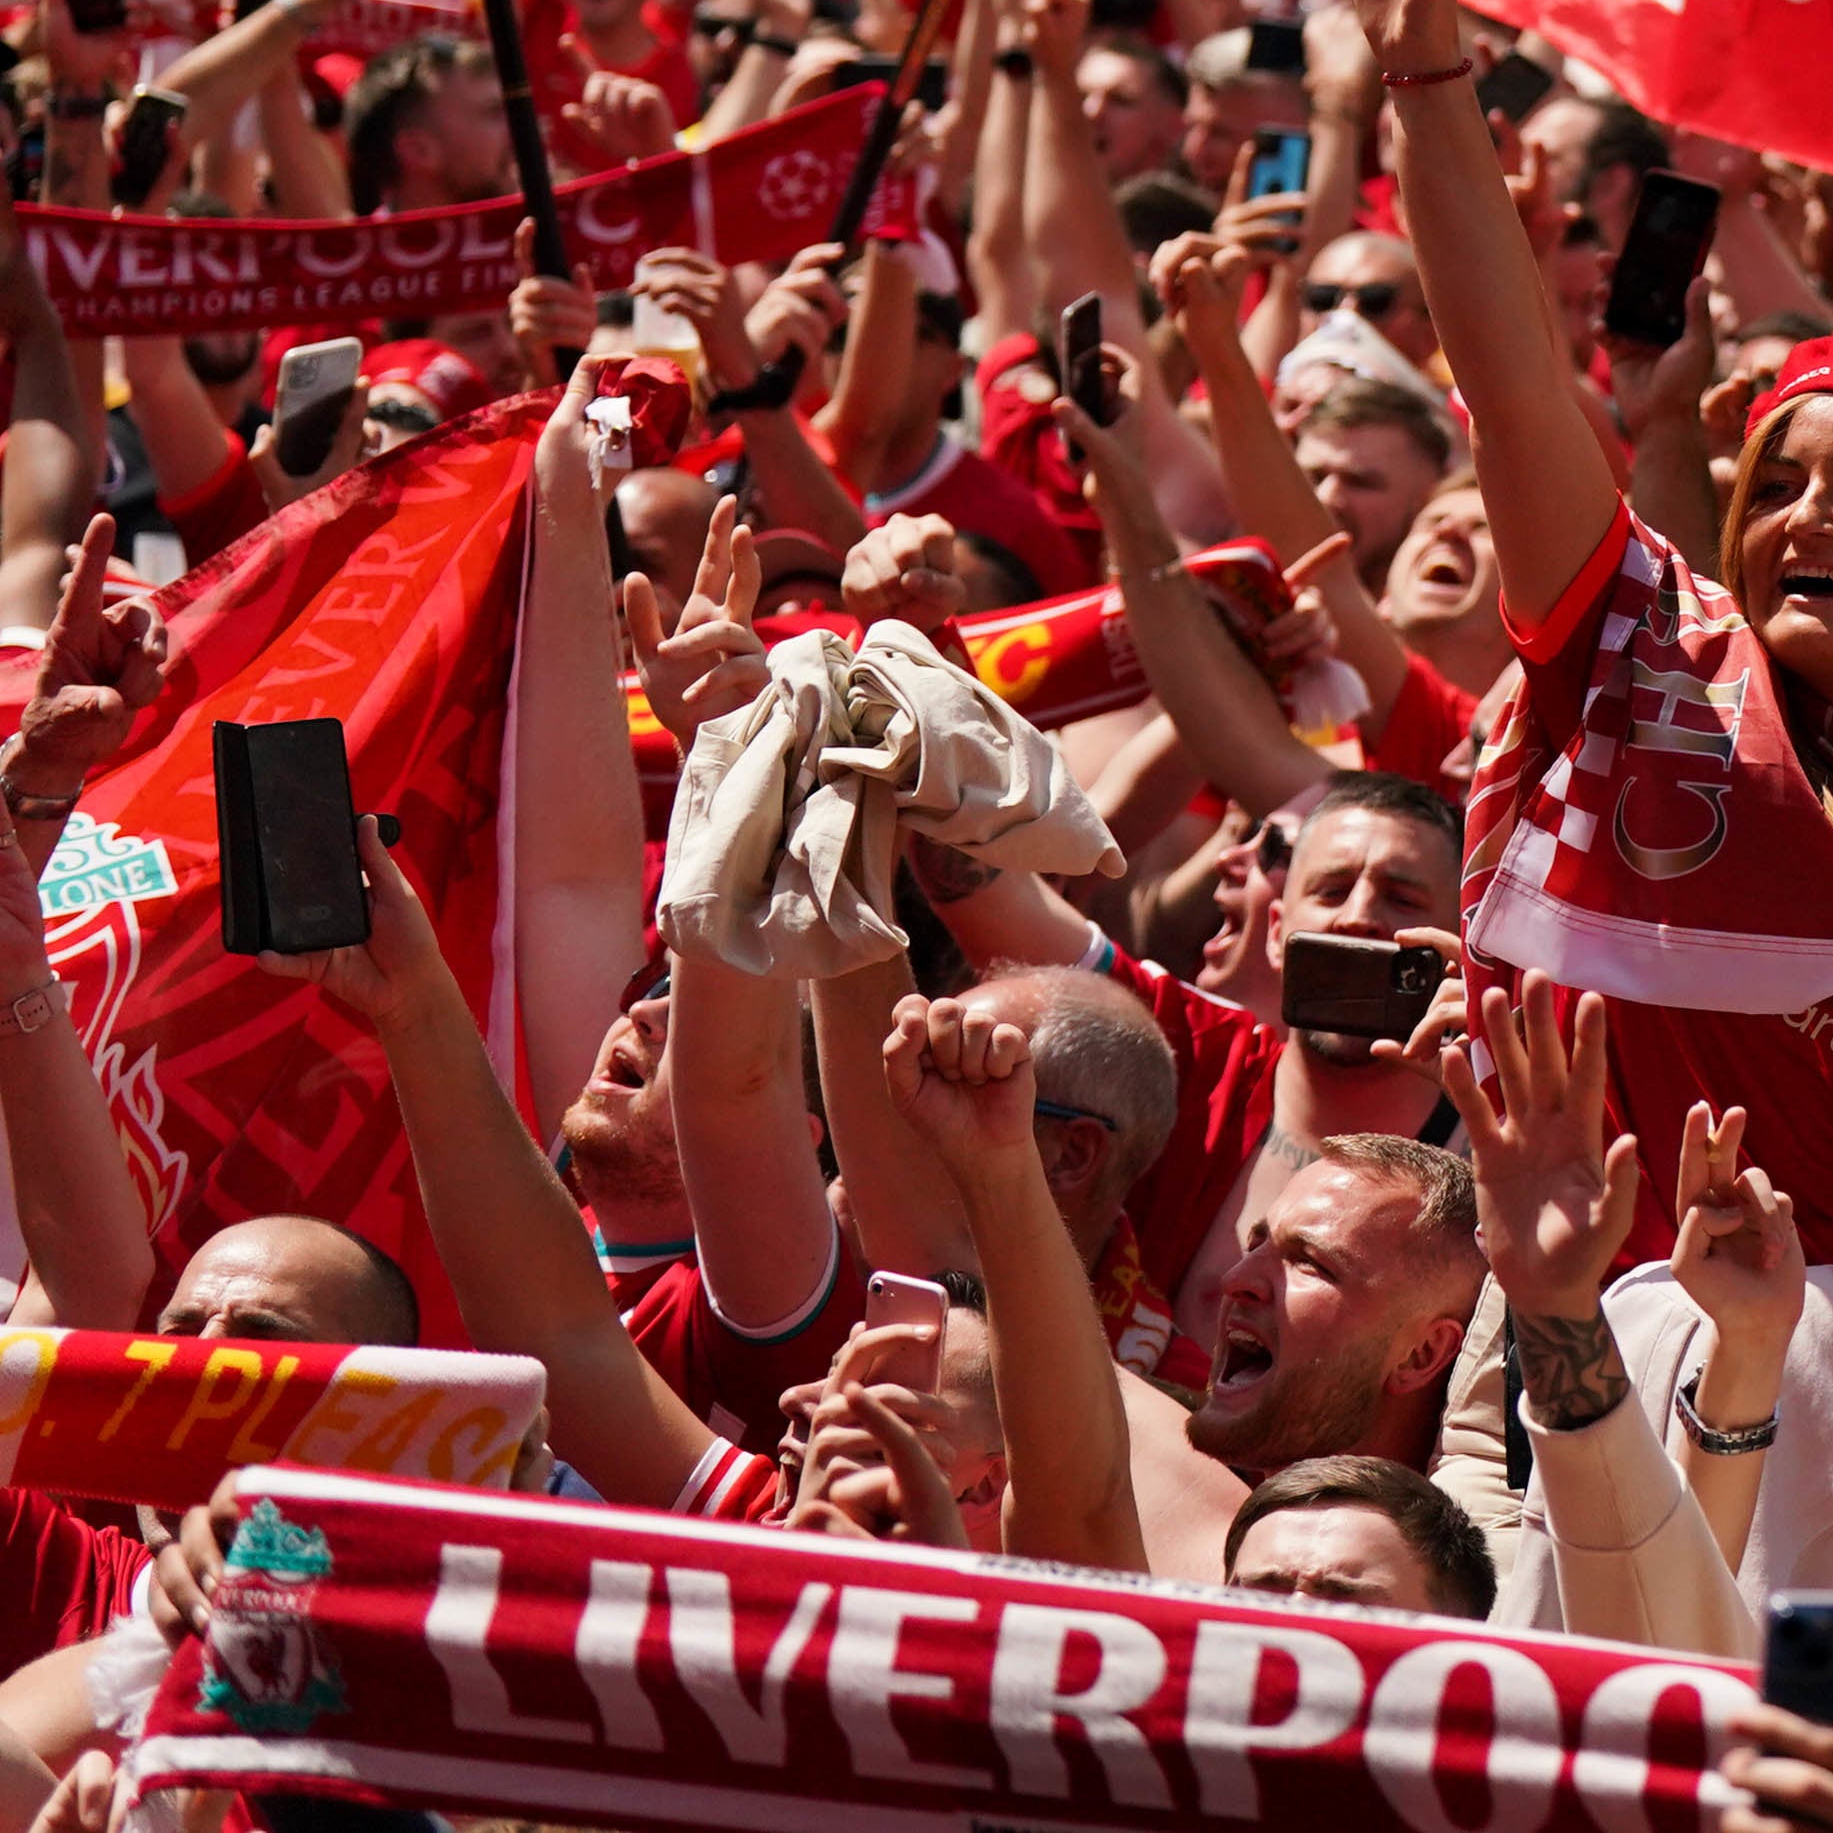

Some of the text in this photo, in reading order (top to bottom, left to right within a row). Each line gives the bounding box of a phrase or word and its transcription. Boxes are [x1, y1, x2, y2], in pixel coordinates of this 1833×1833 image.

[27, 213, 512, 293] IVERPOOL
[304, 270, 441, 306] LEAGUE
[461, 264, 520, 296] FIN
[39, 859, 153, 914] LONE
[99, 1339, 178, 1443] 7
[165, 1347, 522, 1487] PLEAS
[426, 1543, 1760, 1833] LIVERPOO
